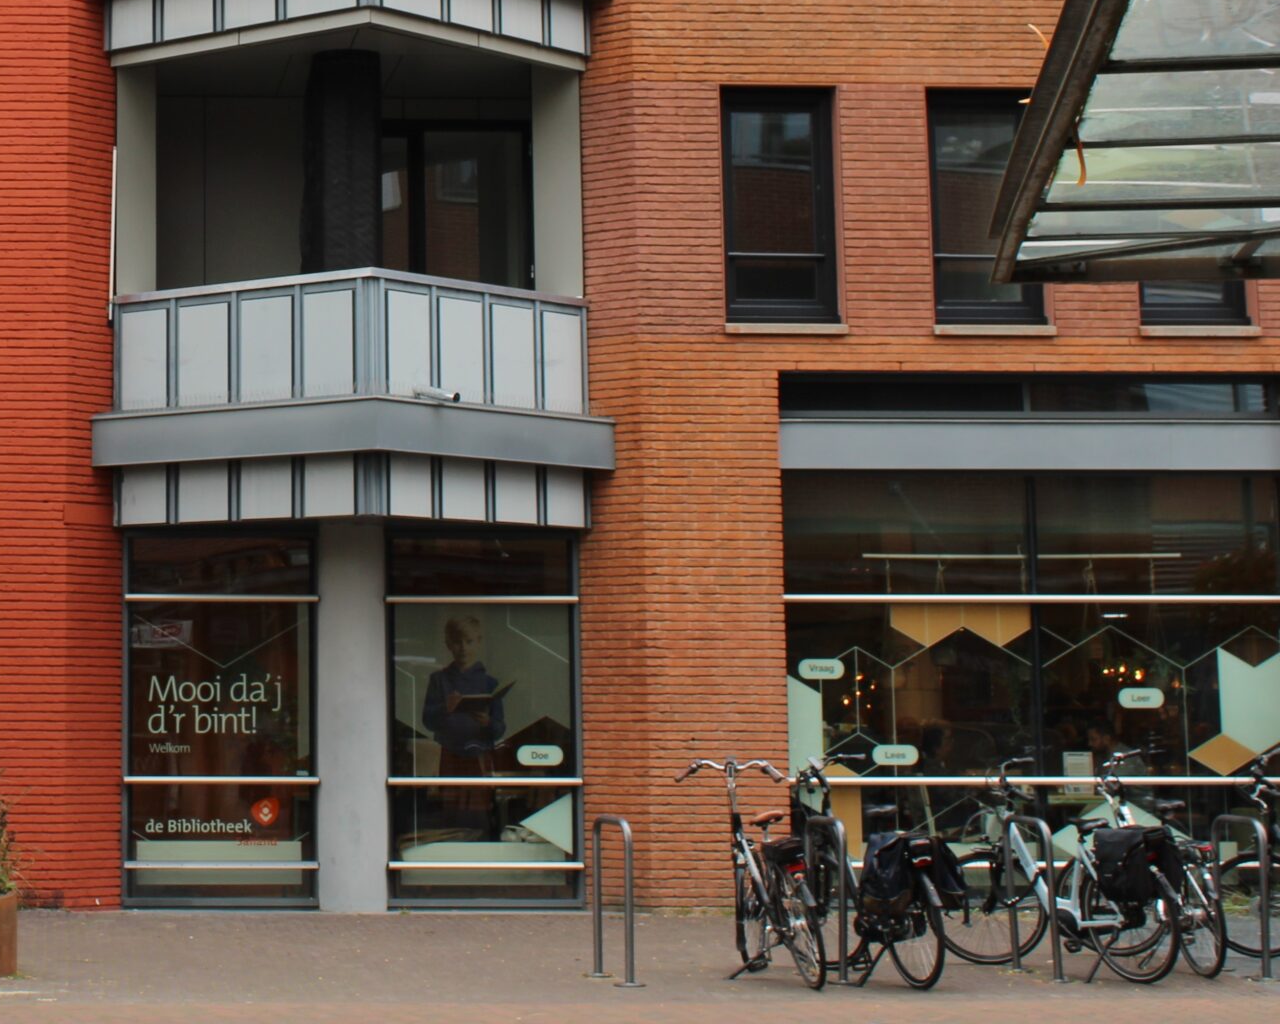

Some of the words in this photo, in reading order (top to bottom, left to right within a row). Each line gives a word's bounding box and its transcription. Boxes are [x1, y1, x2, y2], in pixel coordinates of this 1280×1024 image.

[808, 663, 835, 674] Vraag
[148, 675, 221, 702] Mooi
[192, 704, 257, 734] bint!
[149, 742, 191, 754] Welkom
[531, 751, 549, 760] Doe
[145, 818, 164, 833] de
[167, 818, 253, 833] Bibliotheek
